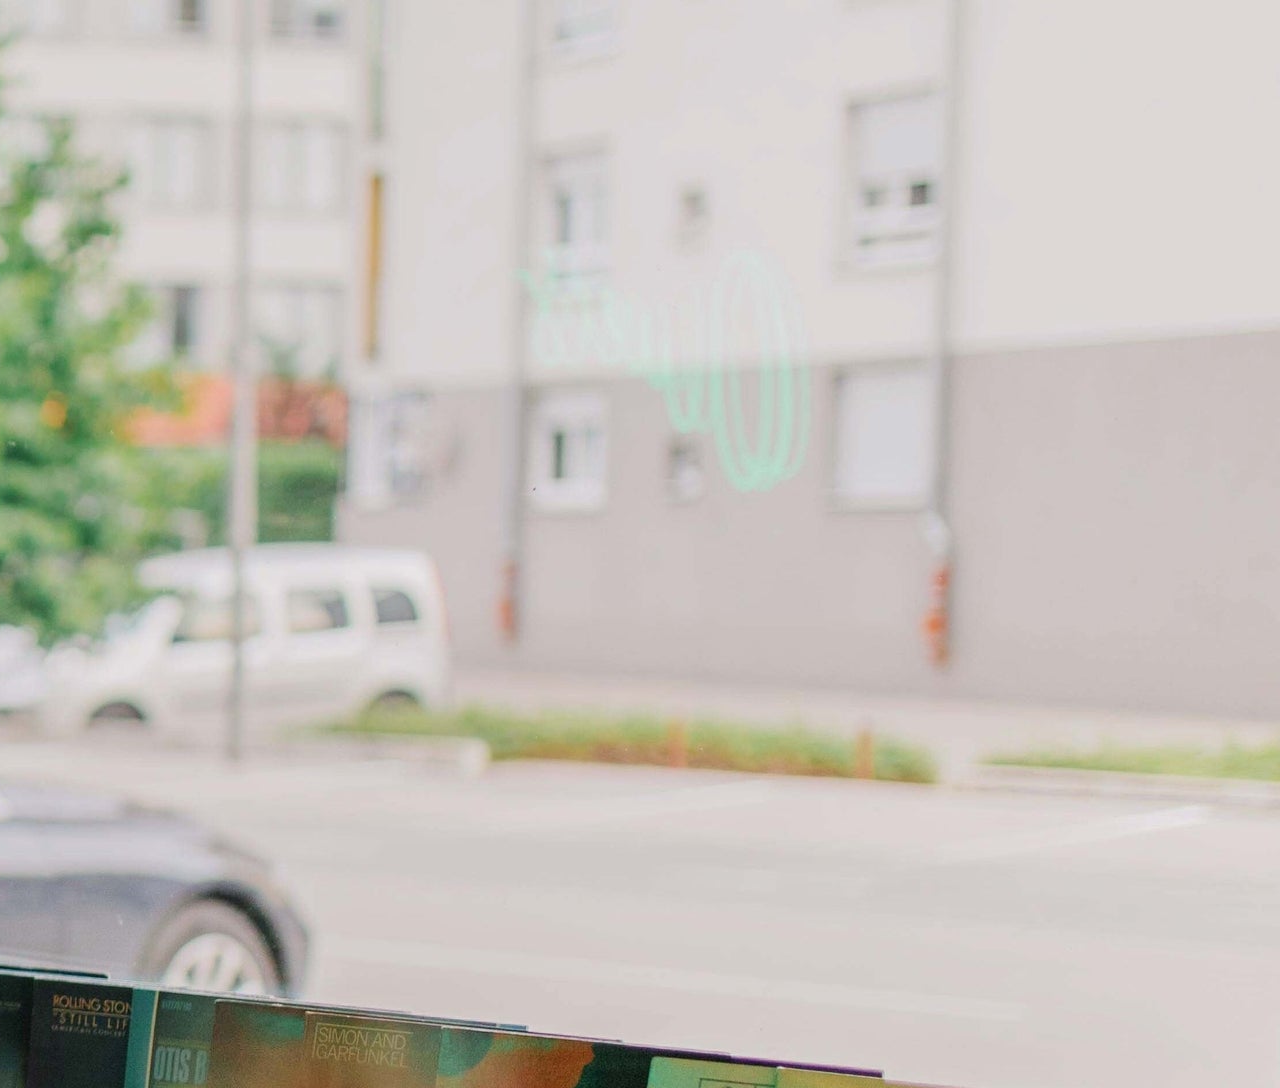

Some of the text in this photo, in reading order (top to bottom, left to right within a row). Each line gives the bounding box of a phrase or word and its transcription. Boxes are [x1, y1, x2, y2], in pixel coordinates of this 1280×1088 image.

[52, 994, 101, 1012] ROLLING
[318, 1026, 407, 1050] SIMON AND
[153, 1046, 192, 1083] OTIS
[316, 1043, 408, 1068] GARFUNKEL
